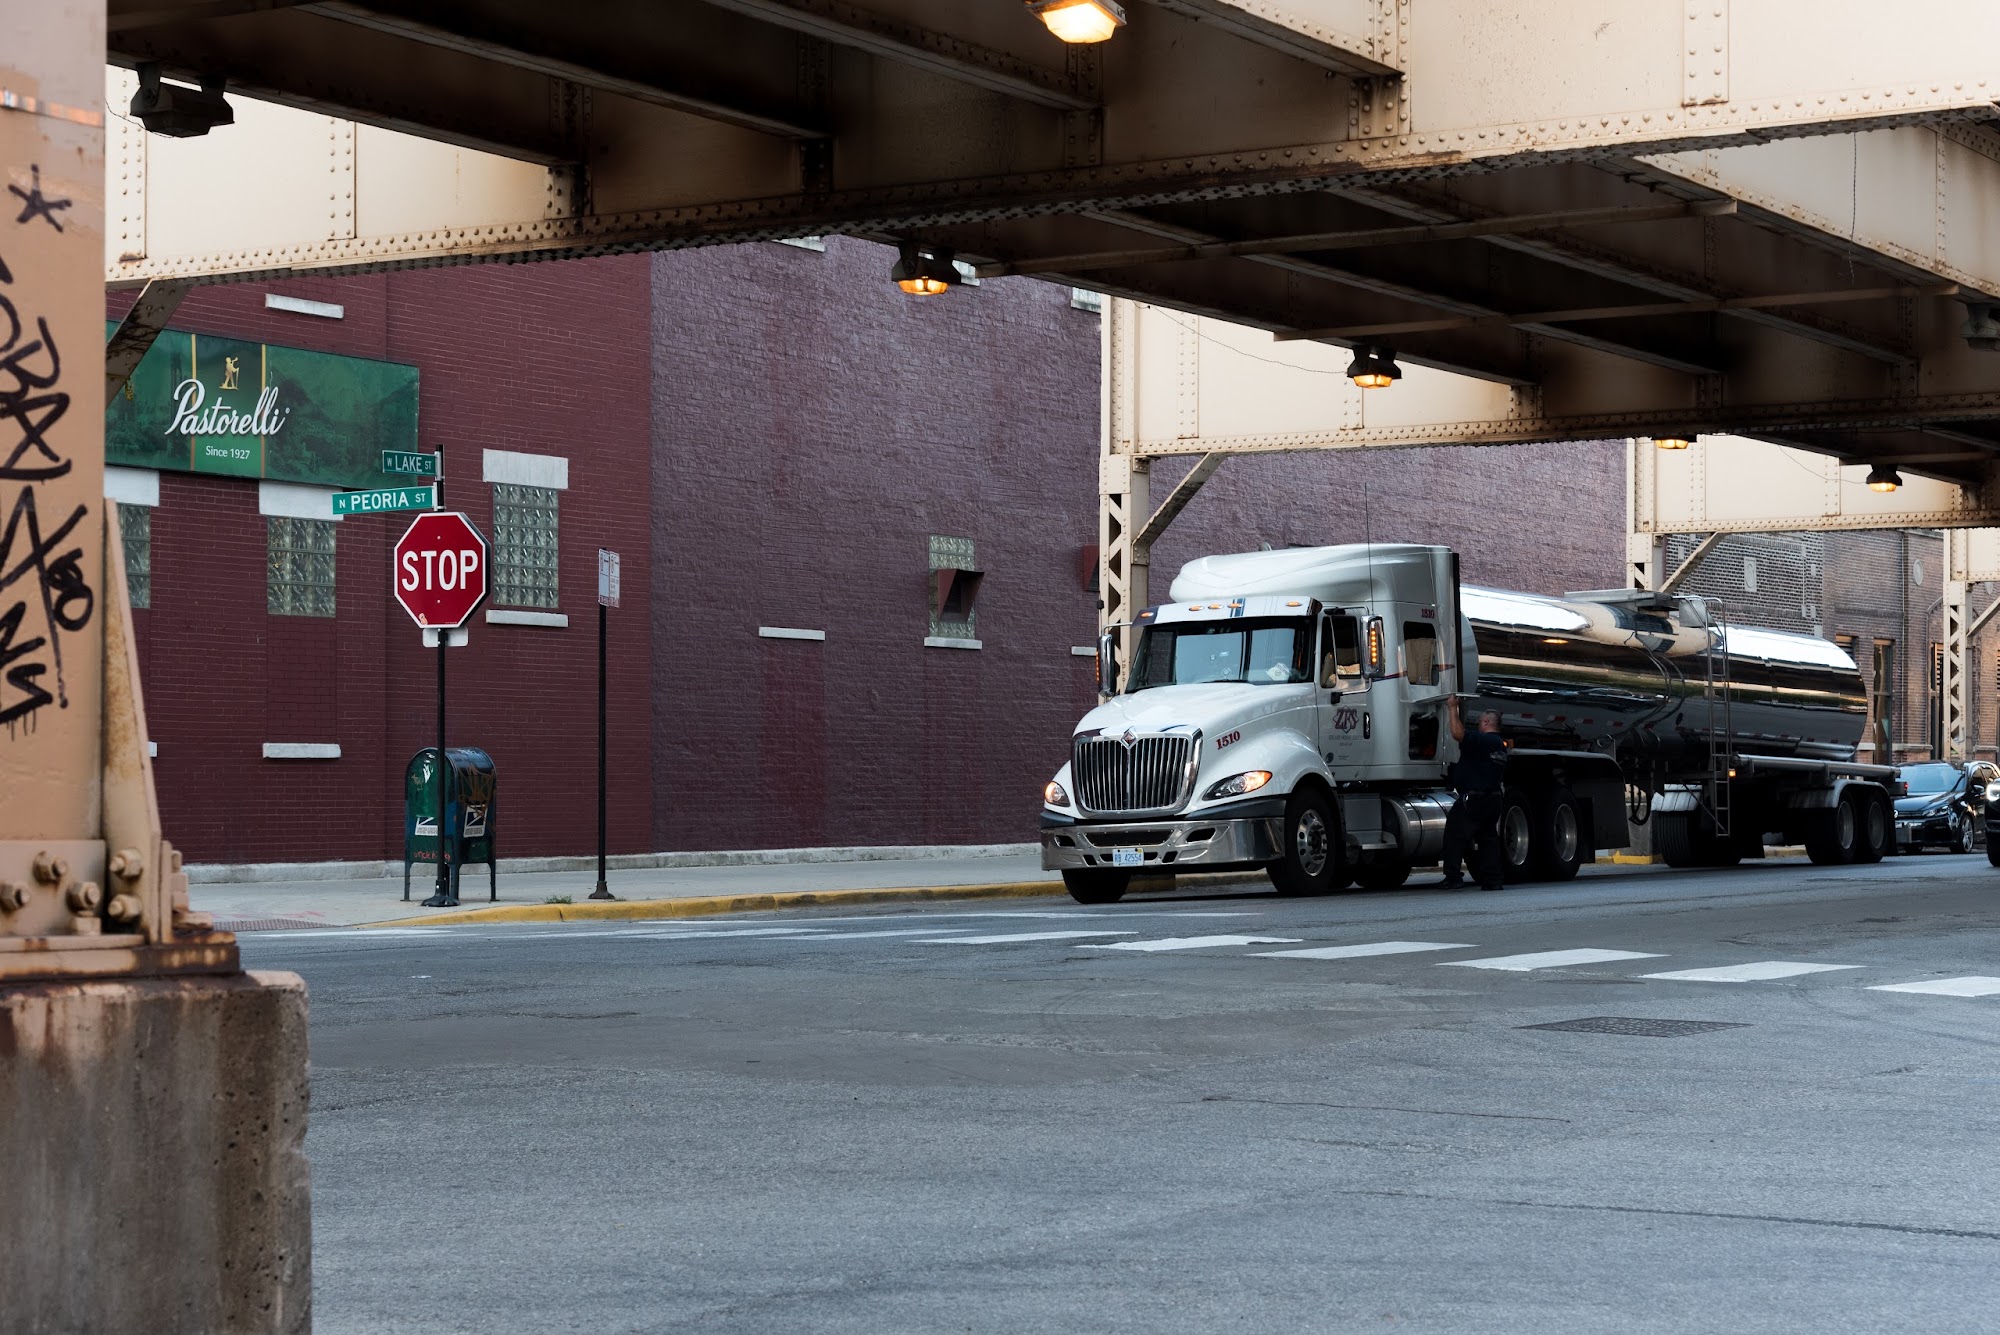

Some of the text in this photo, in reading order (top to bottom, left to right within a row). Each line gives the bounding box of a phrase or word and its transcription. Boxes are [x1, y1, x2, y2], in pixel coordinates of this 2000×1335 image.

[164, 378, 286, 435] Pastorelli
[205, 445, 251, 460] Since 1927
[386, 455, 432, 473] W LAKE ST
[339, 492, 426, 511] N PEORIA ST
[401, 549, 479, 592] STOP
[1421, 608, 1435, 619] 1510
[1334, 708, 1358, 730] ZFS
[1216, 730, 1241, 751] 1510
